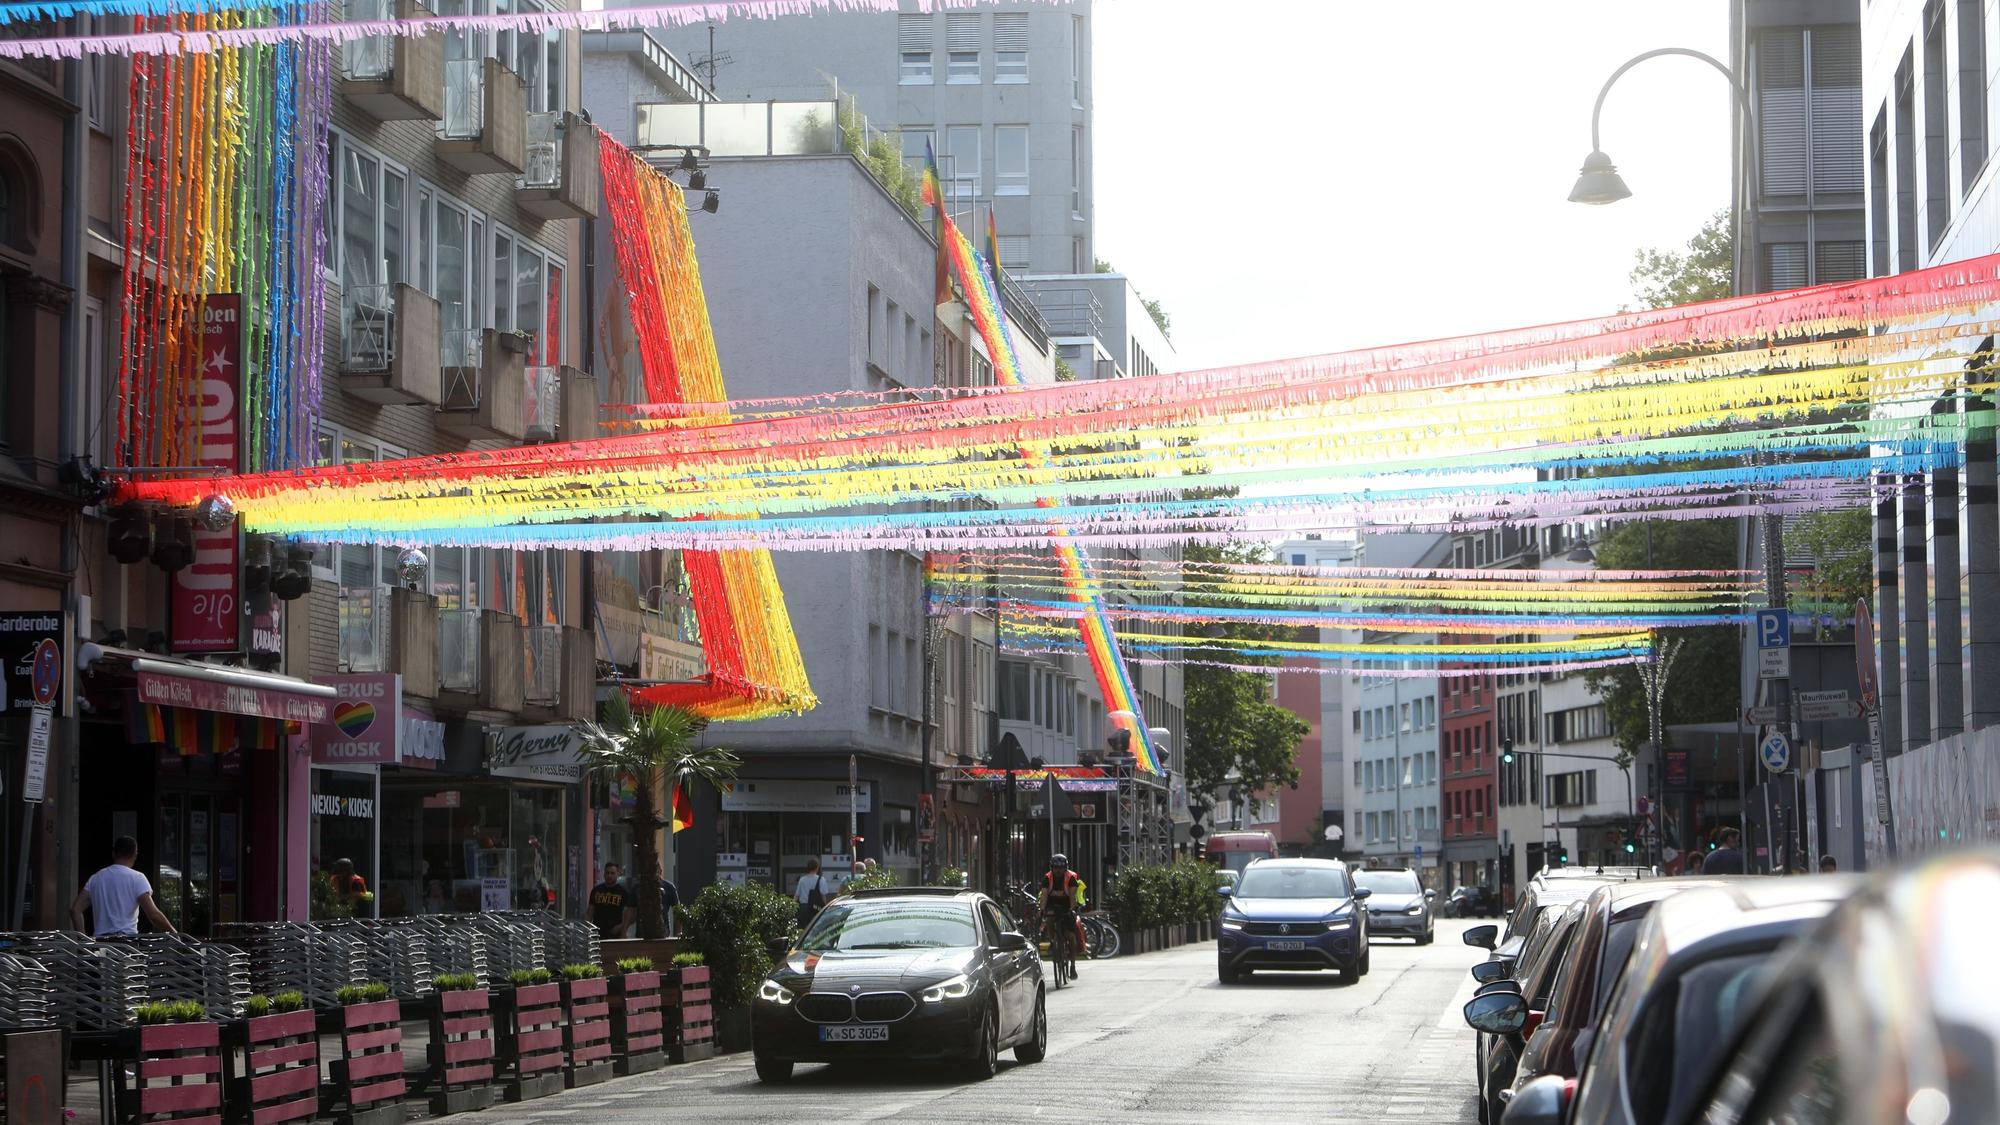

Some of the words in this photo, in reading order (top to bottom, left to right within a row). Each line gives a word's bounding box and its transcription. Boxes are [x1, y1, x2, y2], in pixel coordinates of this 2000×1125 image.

[0, 616, 58, 631] arderobe
[1761, 614, 1779, 646] P
[145, 679, 169, 699] Gilden
[170, 682, 192, 702] Kölsch
[1801, 692, 1846, 702] Mauritiuswall
[326, 742, 381, 757] KIOSK
[402, 718, 446, 760] KIOSK
[505, 730, 571, 764] Gerny
[312, 794, 340, 816] NEXUS
[349, 798, 373, 819] KIOSK
[826, 1027, 834, 1040] K
[841, 1028, 856, 1040] SC
[858, 1027, 887, 1040] 3054
